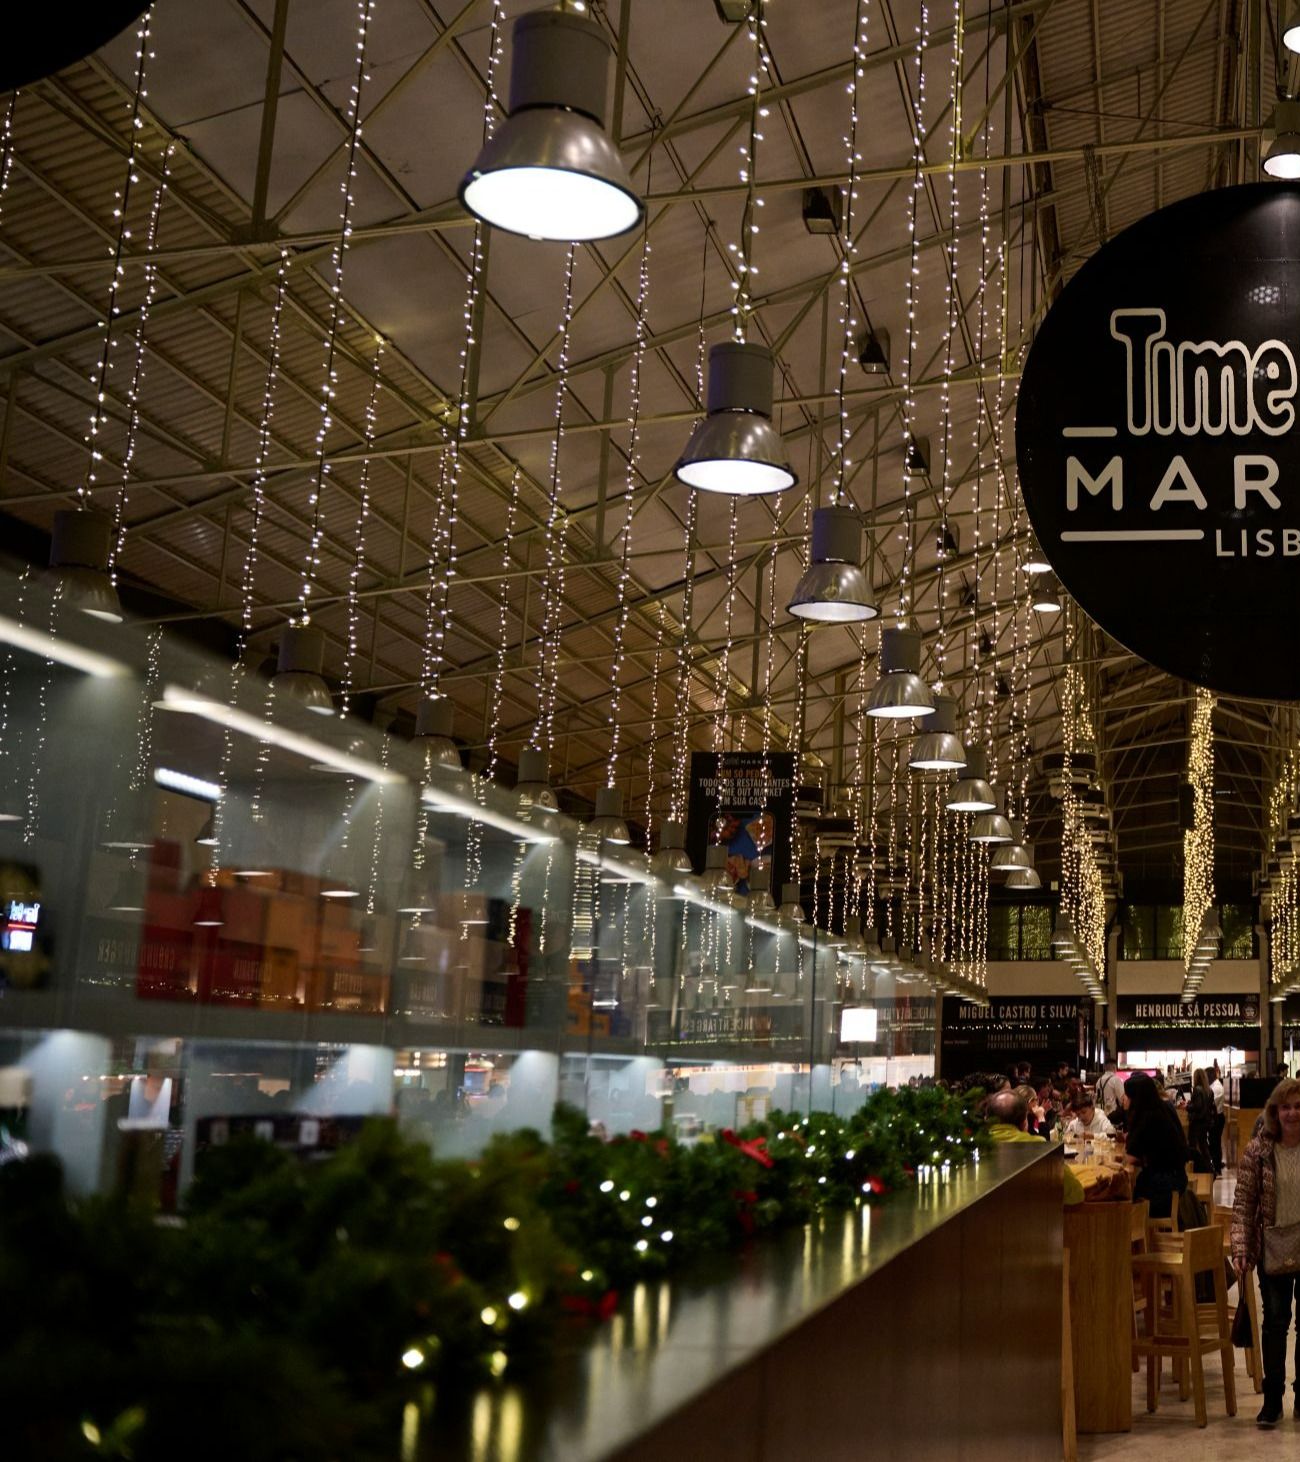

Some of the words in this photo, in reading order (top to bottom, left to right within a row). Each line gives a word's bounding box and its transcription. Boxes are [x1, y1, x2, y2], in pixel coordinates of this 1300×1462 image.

[1110, 307, 1298, 436] Time
[737, 778, 791, 789] RESTAUANTES
[737, 788, 751, 797] OUT
[732, 797, 747, 806] SUA
[960, 1005, 996, 1019] MIGUEL
[1000, 1005, 1037, 1019] CASTRO
[1040, 1005, 1047, 1019] E
[1049, 1005, 1078, 1019] SILVA
[1135, 1003, 1184, 1018] HENRIQUE
[1187, 1000, 1200, 1017] SÁ
[1203, 1003, 1241, 1017] PESSOA
